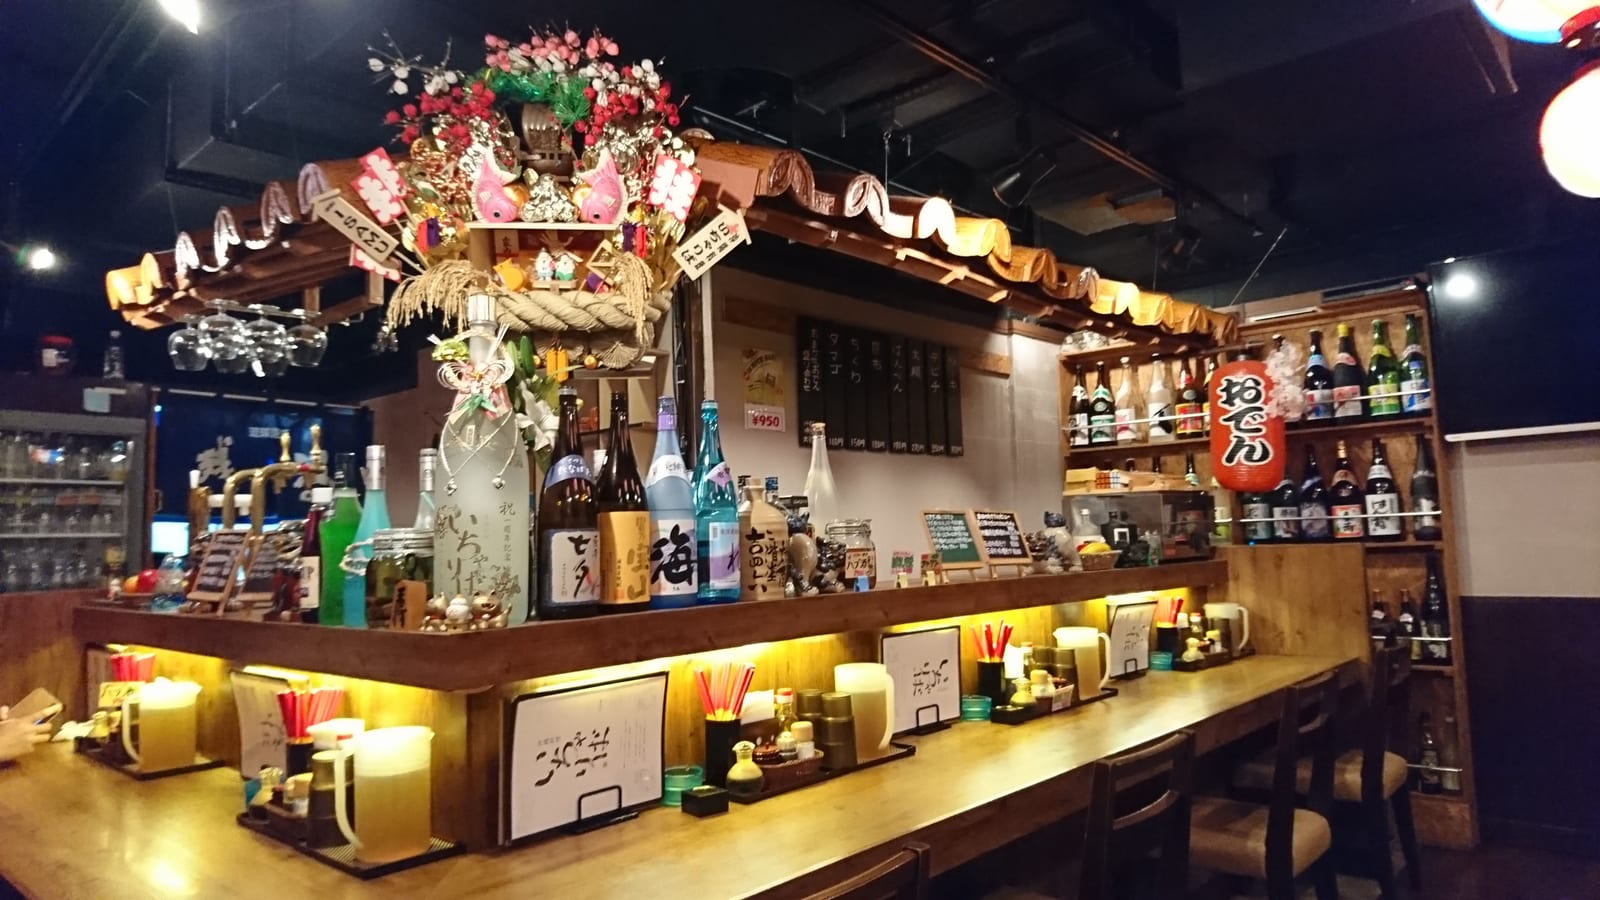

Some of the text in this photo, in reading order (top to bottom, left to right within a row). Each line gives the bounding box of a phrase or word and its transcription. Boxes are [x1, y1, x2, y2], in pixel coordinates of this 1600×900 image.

[334, 209, 389, 254] ISAMU
[681, 222, 730, 265] いちゃりば
[752, 415, 780, 428] ¥950
[1218, 375, 1272, 466] おでん
[499, 502, 516, 516] 祝
[567, 534, 591, 598] 七夕
[650, 524, 697, 586] 海
